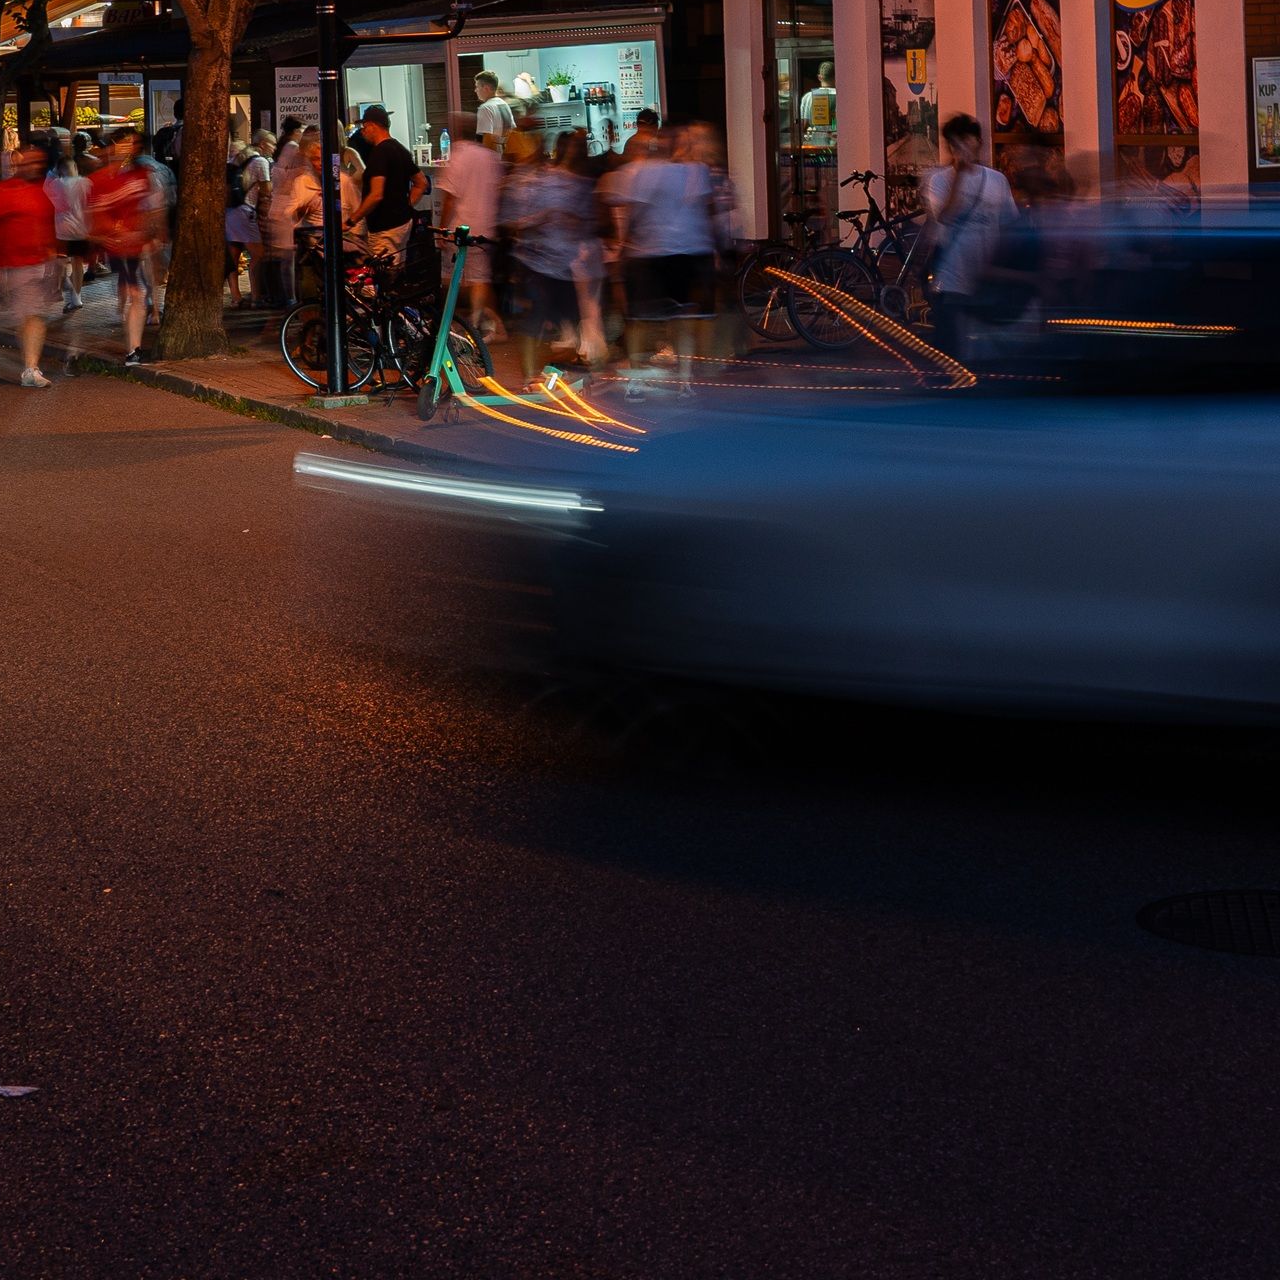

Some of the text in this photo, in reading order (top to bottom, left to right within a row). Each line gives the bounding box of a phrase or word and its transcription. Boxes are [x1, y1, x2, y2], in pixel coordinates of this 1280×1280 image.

[278, 74, 303, 82] SKLEP
[1258, 83, 1278, 97] KUP
[279, 96, 318, 104] WARZYWA
[279, 104, 308, 113] OWOCE
